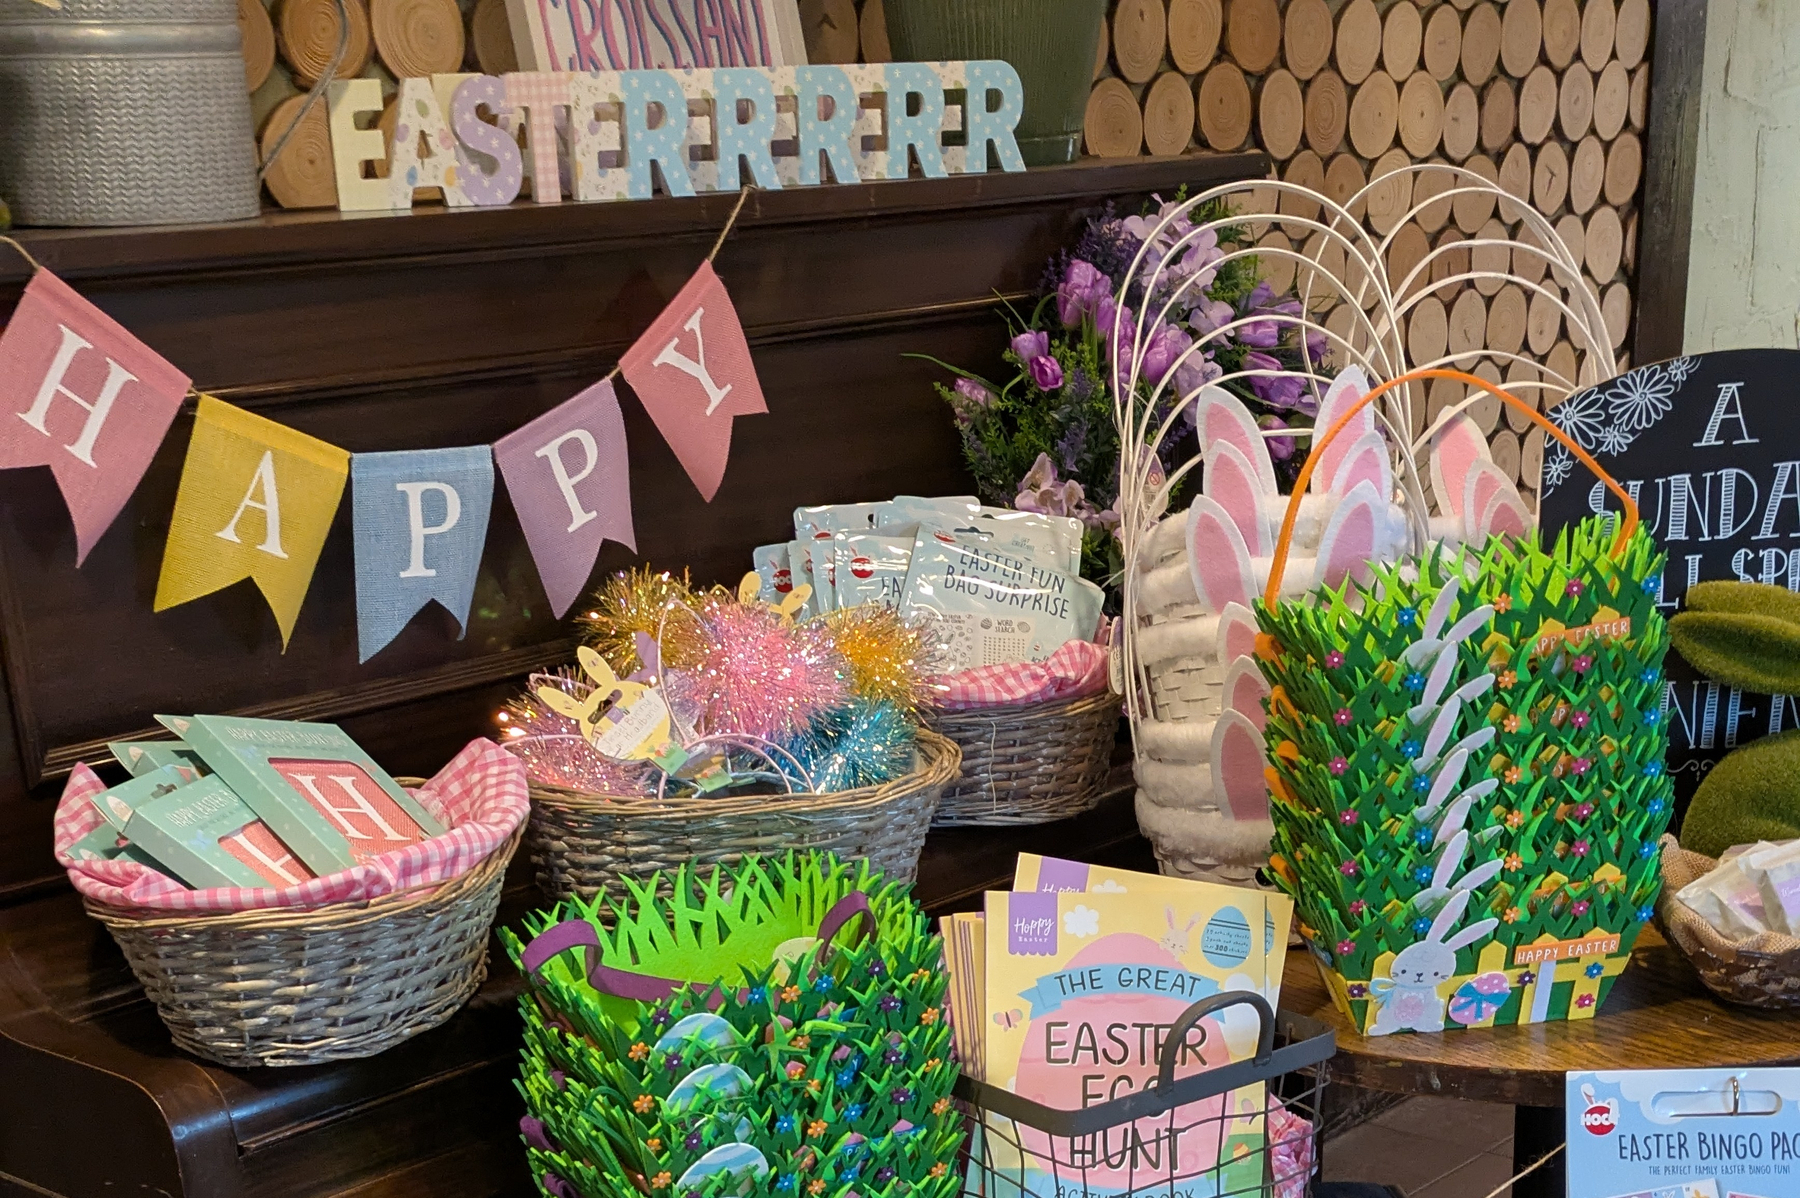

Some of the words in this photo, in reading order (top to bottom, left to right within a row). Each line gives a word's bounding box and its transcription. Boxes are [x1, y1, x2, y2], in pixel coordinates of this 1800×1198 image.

[1693, 382, 1759, 447] A
[959, 545, 1024, 581] EASTER
[1030, 566, 1066, 594] FUN
[944, 564, 979, 595] BAG
[984, 577, 1070, 620] SURPRISE
[287, 772, 412, 842] H
[1014, 917, 1054, 937] Hoppy
[1517, 947, 1560, 964] HAPPY
[1567, 940, 1617, 956] EASTER
[1054, 968, 1104, 996] THE
[1117, 967, 1202, 998] GREAT
[1046, 1021, 1208, 1067] EASTER
[1069, 1127, 1187, 1171] HUNT
[1618, 1132, 1690, 1161] EASTER
[1697, 1132, 1763, 1160] BINGO
[1649, 1165, 1660, 1176] THE
[1664, 1165, 1691, 1176] PERFECT
[1695, 1165, 1718, 1175] FAMILY
[1721, 1164, 1746, 1175] EASTER
[1749, 1164, 1771, 1175] BINGO
